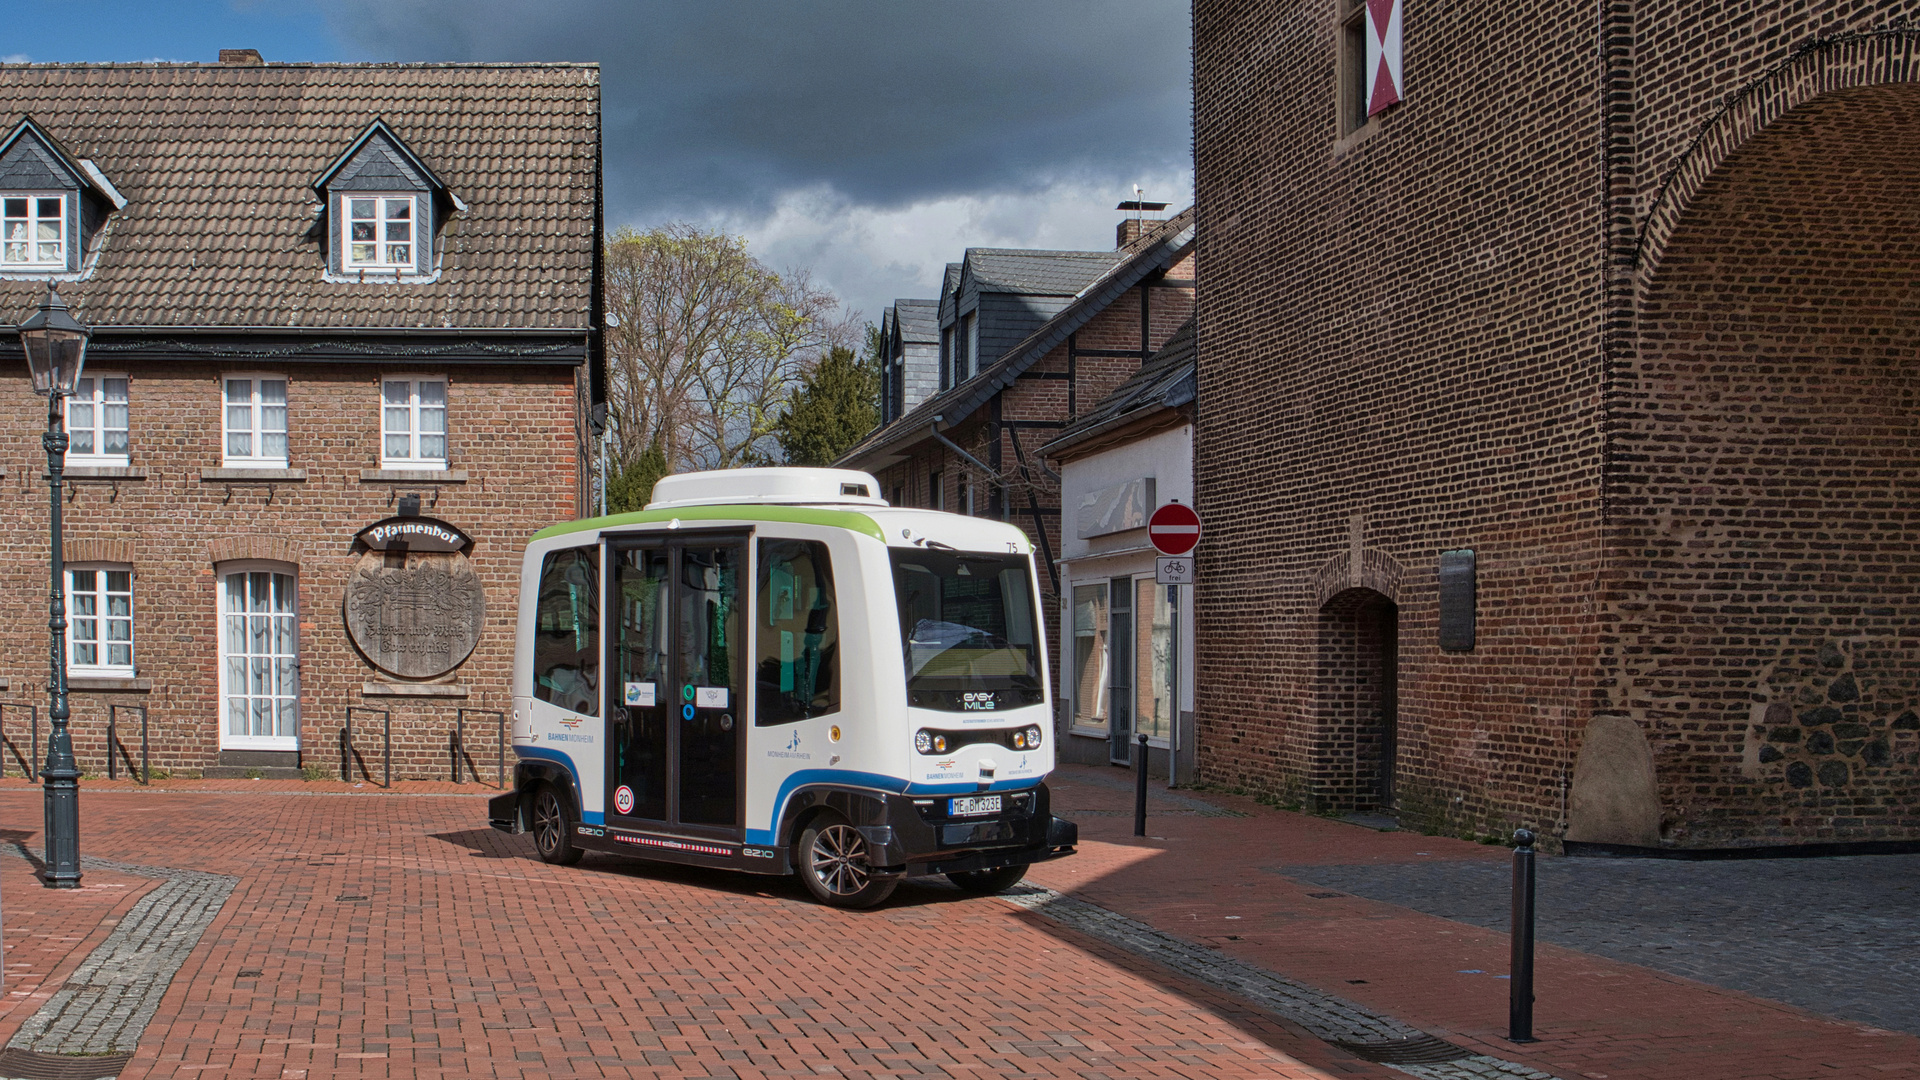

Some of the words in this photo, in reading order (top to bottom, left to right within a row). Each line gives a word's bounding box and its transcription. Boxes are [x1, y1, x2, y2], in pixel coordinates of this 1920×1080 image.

[369, 524, 459, 543] Pfannenhof
[1006, 542, 1018, 553] 75
[409, 625, 430, 636] und
[619, 793, 630, 805] 20
[954, 799, 964, 812] ME
